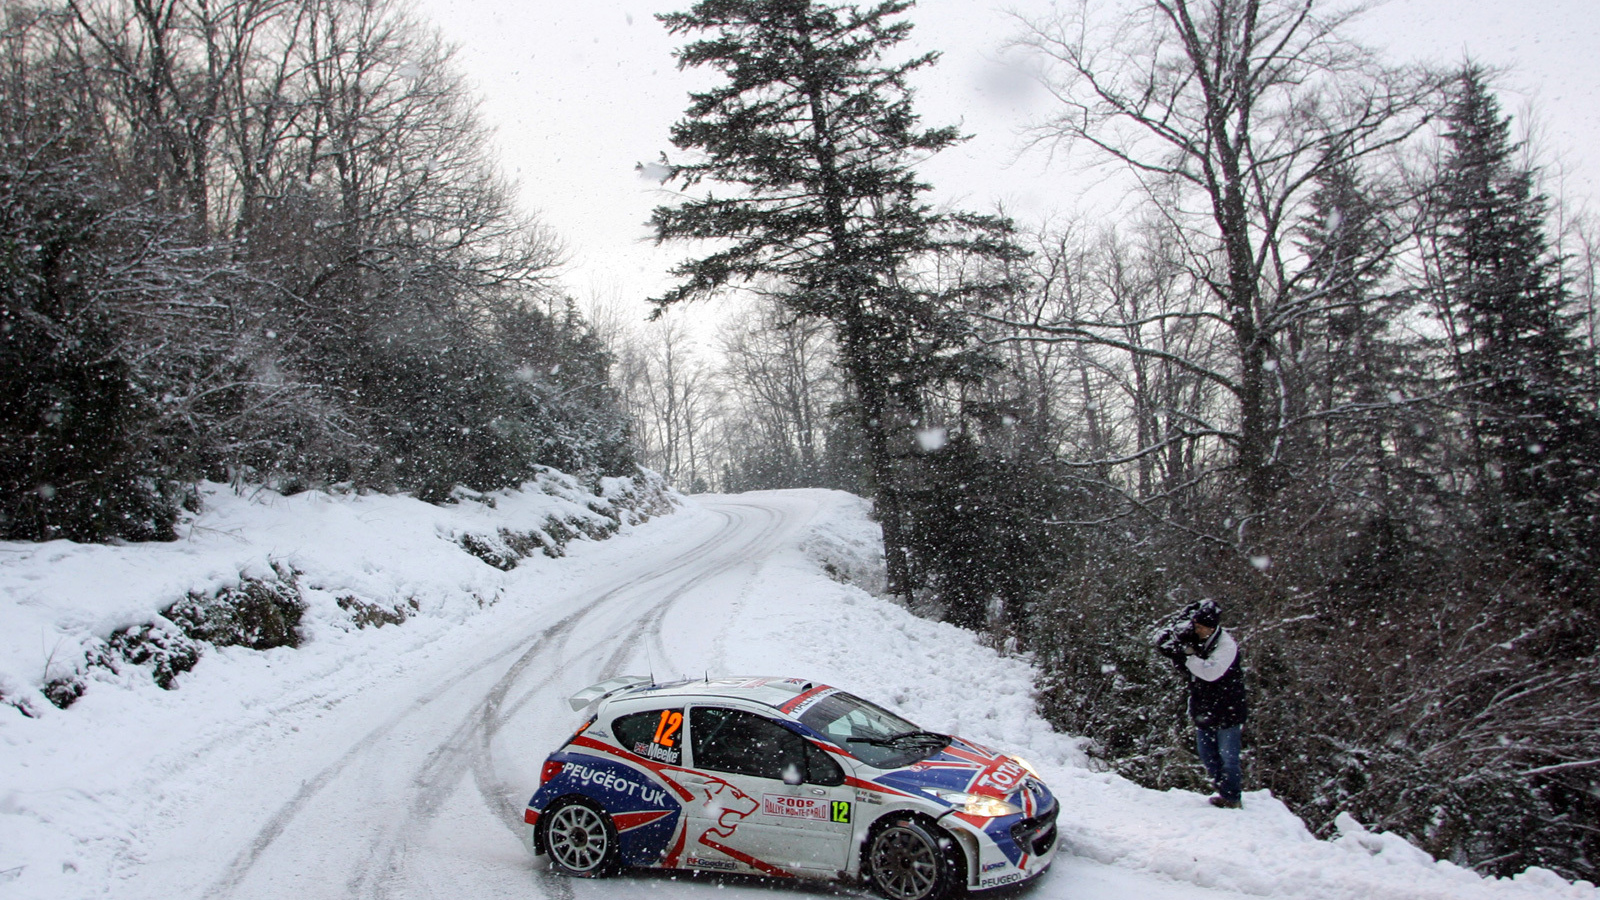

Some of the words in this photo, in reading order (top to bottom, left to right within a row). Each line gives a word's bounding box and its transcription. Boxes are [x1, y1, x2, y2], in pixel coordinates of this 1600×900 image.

[653, 709, 684, 747] 12
[647, 742, 678, 763] Meeke
[562, 762, 640, 796] PEUGEOT
[640, 786, 667, 807] UK
[764, 798, 784, 814] RALLYE
[777, 797, 815, 808] 2009
[831, 801, 850, 823] 12
